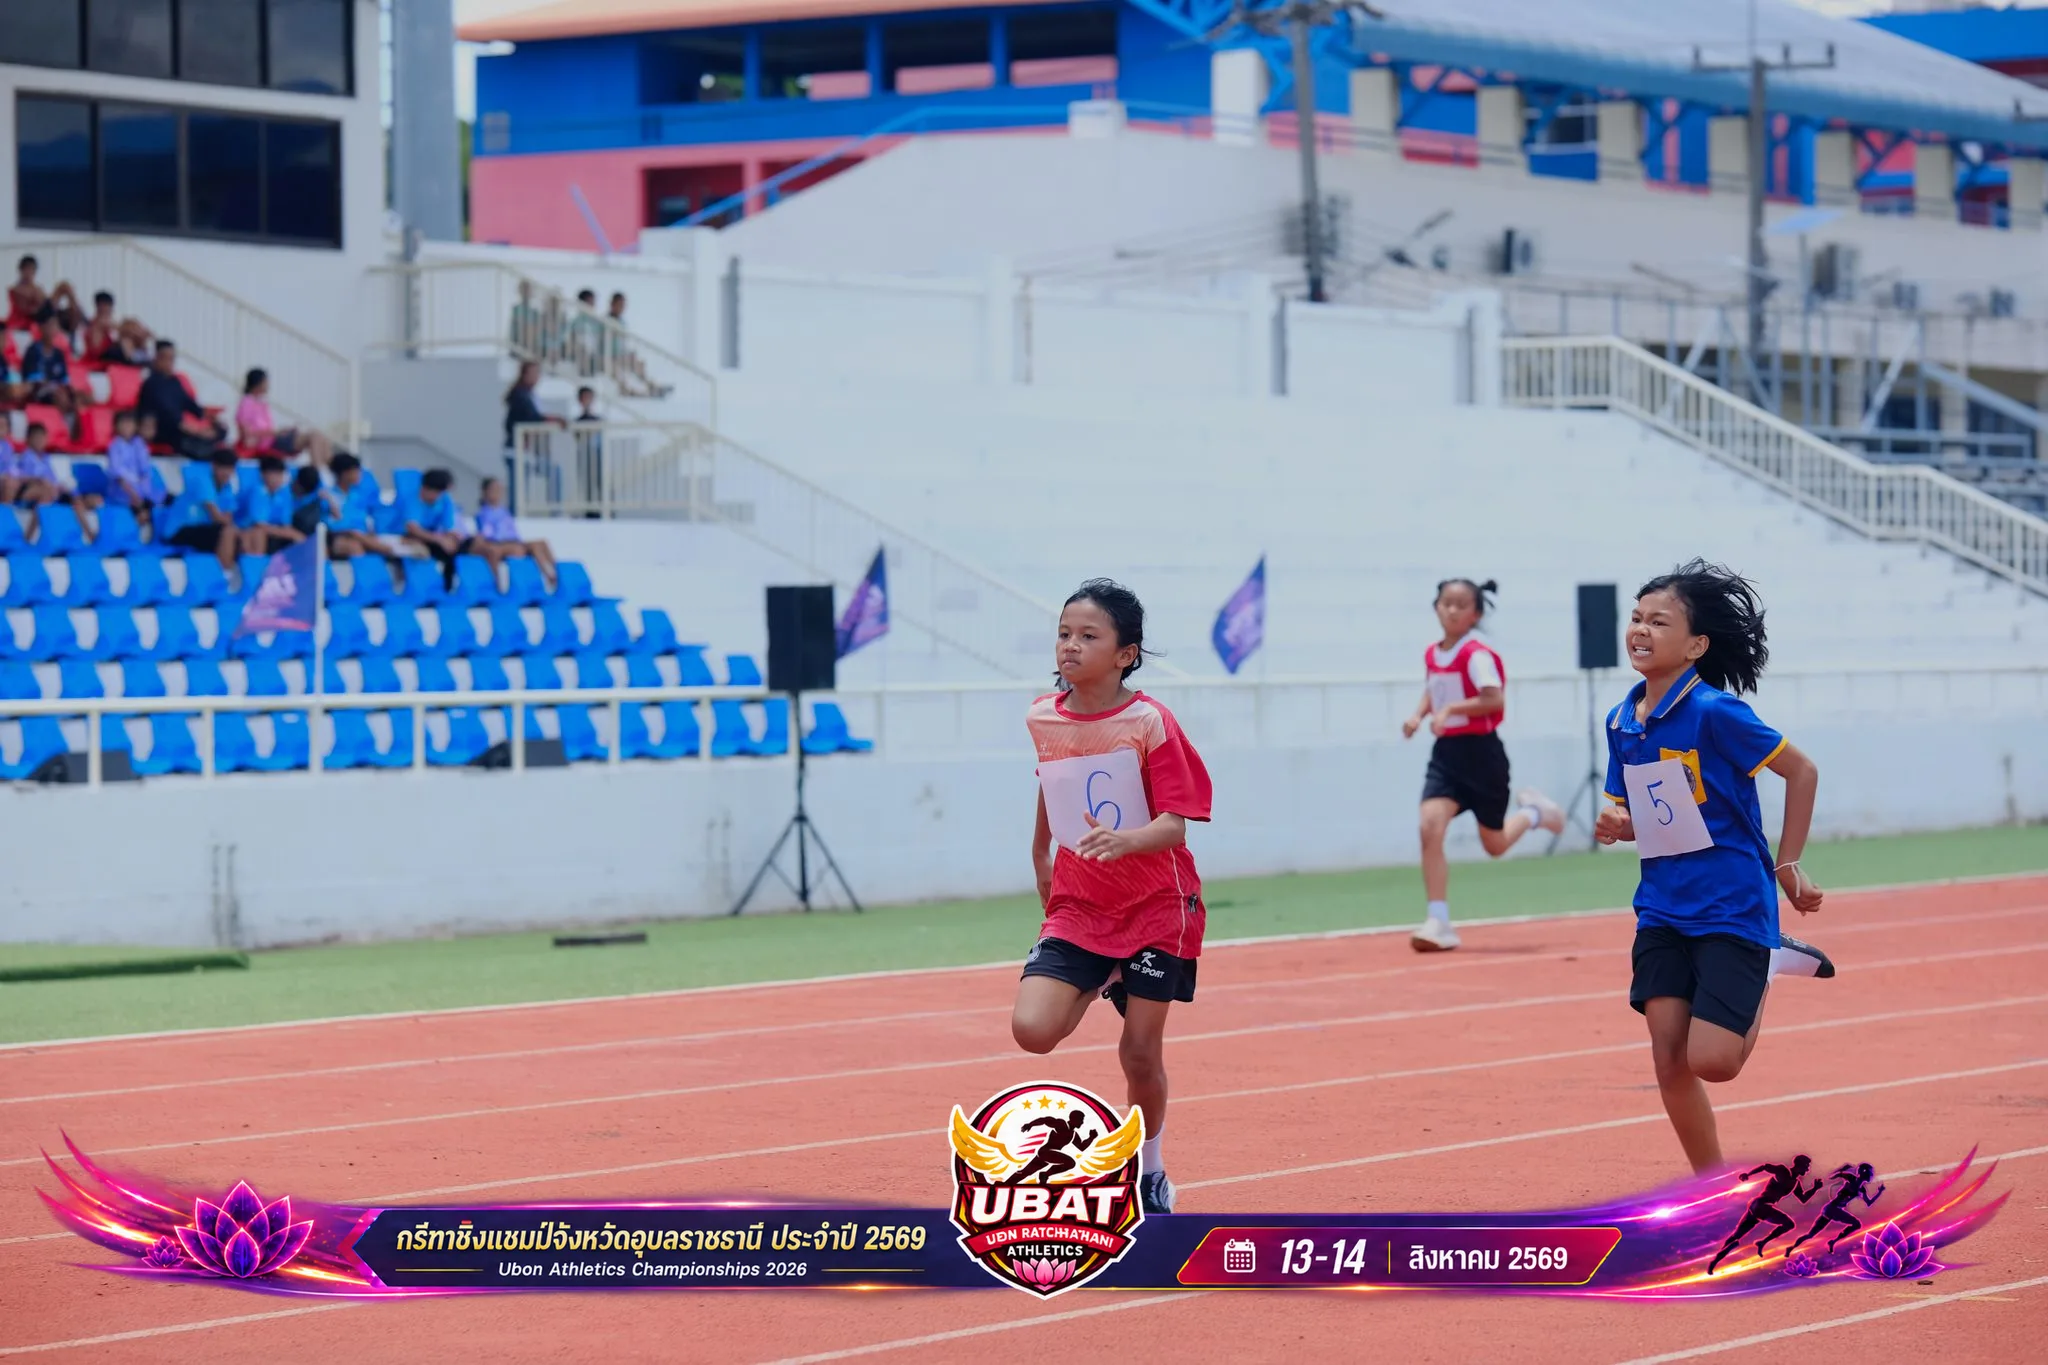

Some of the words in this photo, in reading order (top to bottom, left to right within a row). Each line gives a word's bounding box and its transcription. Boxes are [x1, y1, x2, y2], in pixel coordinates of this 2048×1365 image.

[1085, 770, 1122, 831] 6
[1646, 780, 1674, 826] 5
[1141, 966, 1165, 979] SPORT
